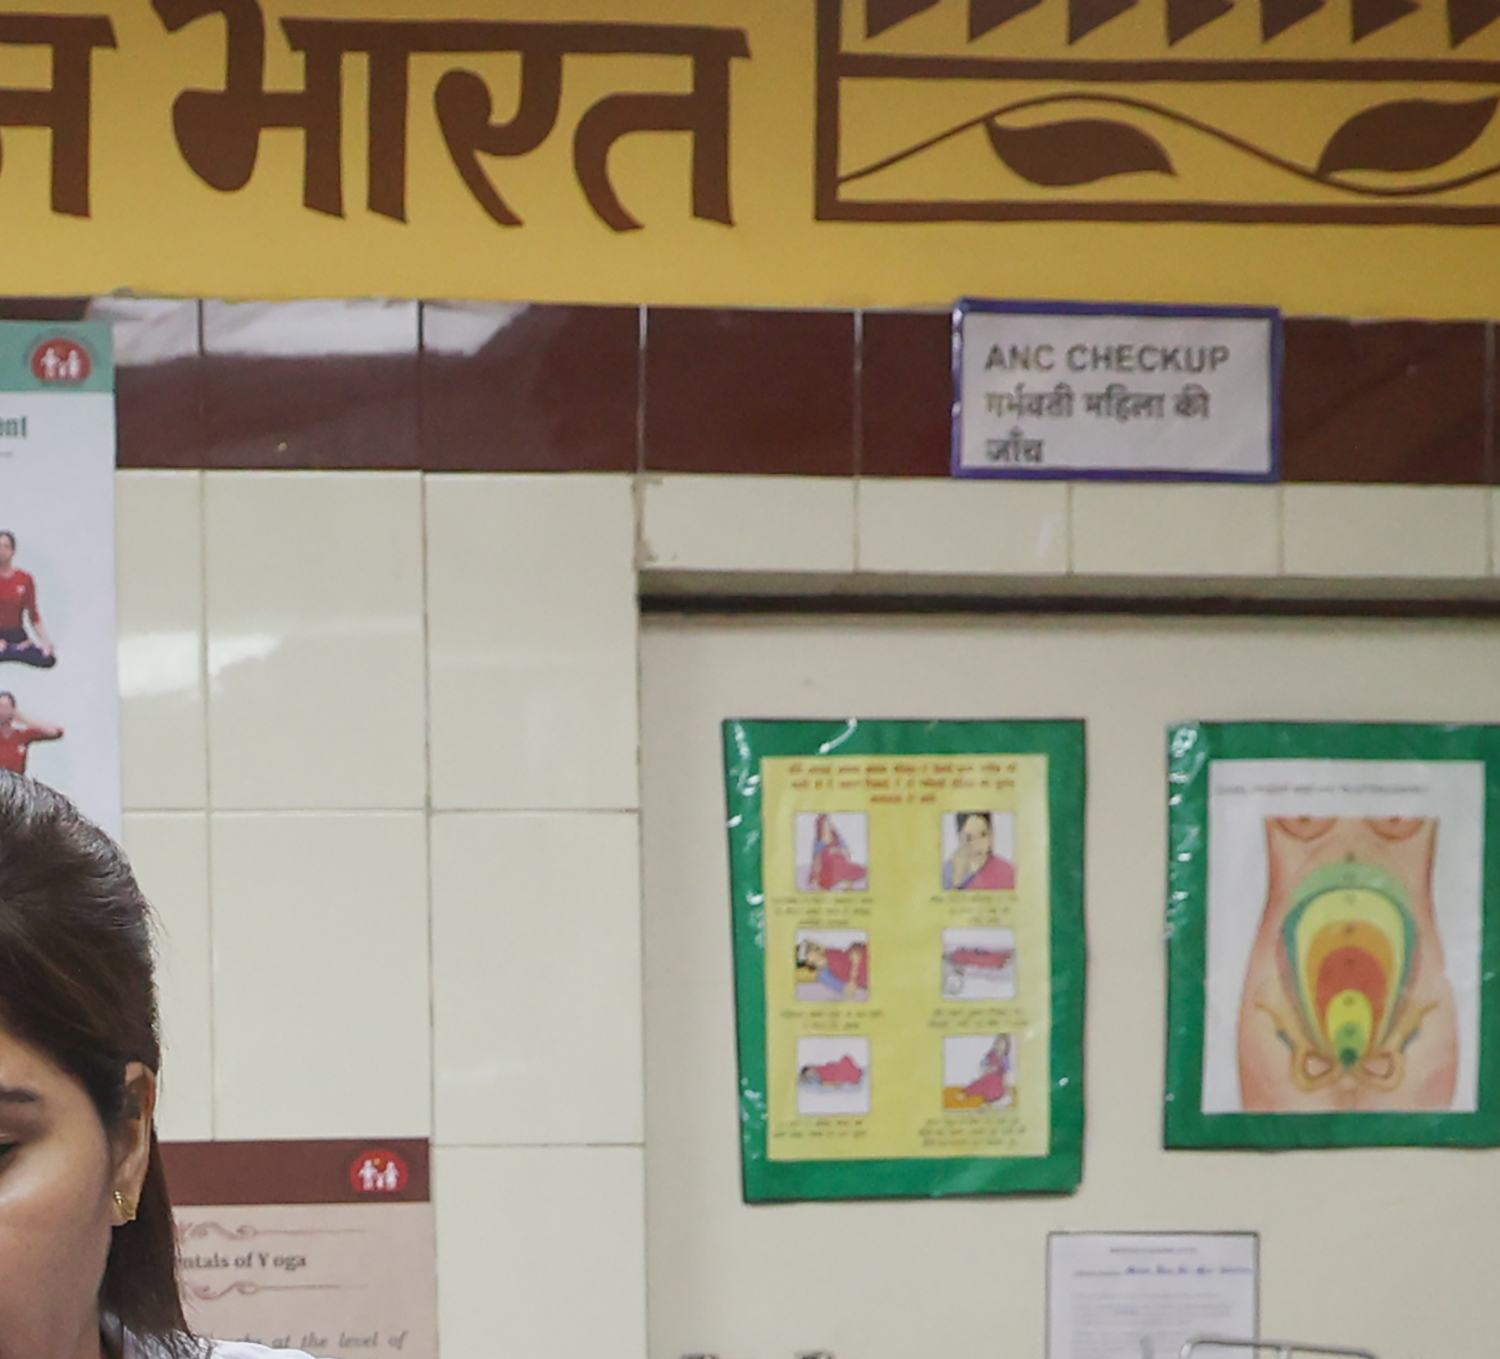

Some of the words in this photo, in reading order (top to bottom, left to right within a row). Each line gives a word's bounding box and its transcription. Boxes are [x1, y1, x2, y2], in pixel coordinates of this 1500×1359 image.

[152, 0, 751, 233] भारत
[984, 344, 1054, 371] ANC
[1067, 345, 1231, 373] CHECKUP
[1083, 383, 1165, 421] महिला
[1173, 382, 1211, 418] की
[235, 1251, 253, 1268] of
[272, 1335, 291, 1348] at
[301, 1332, 329, 1349] the
[338, 1331, 379, 1349] level
[387, 1330, 409, 1349] of
